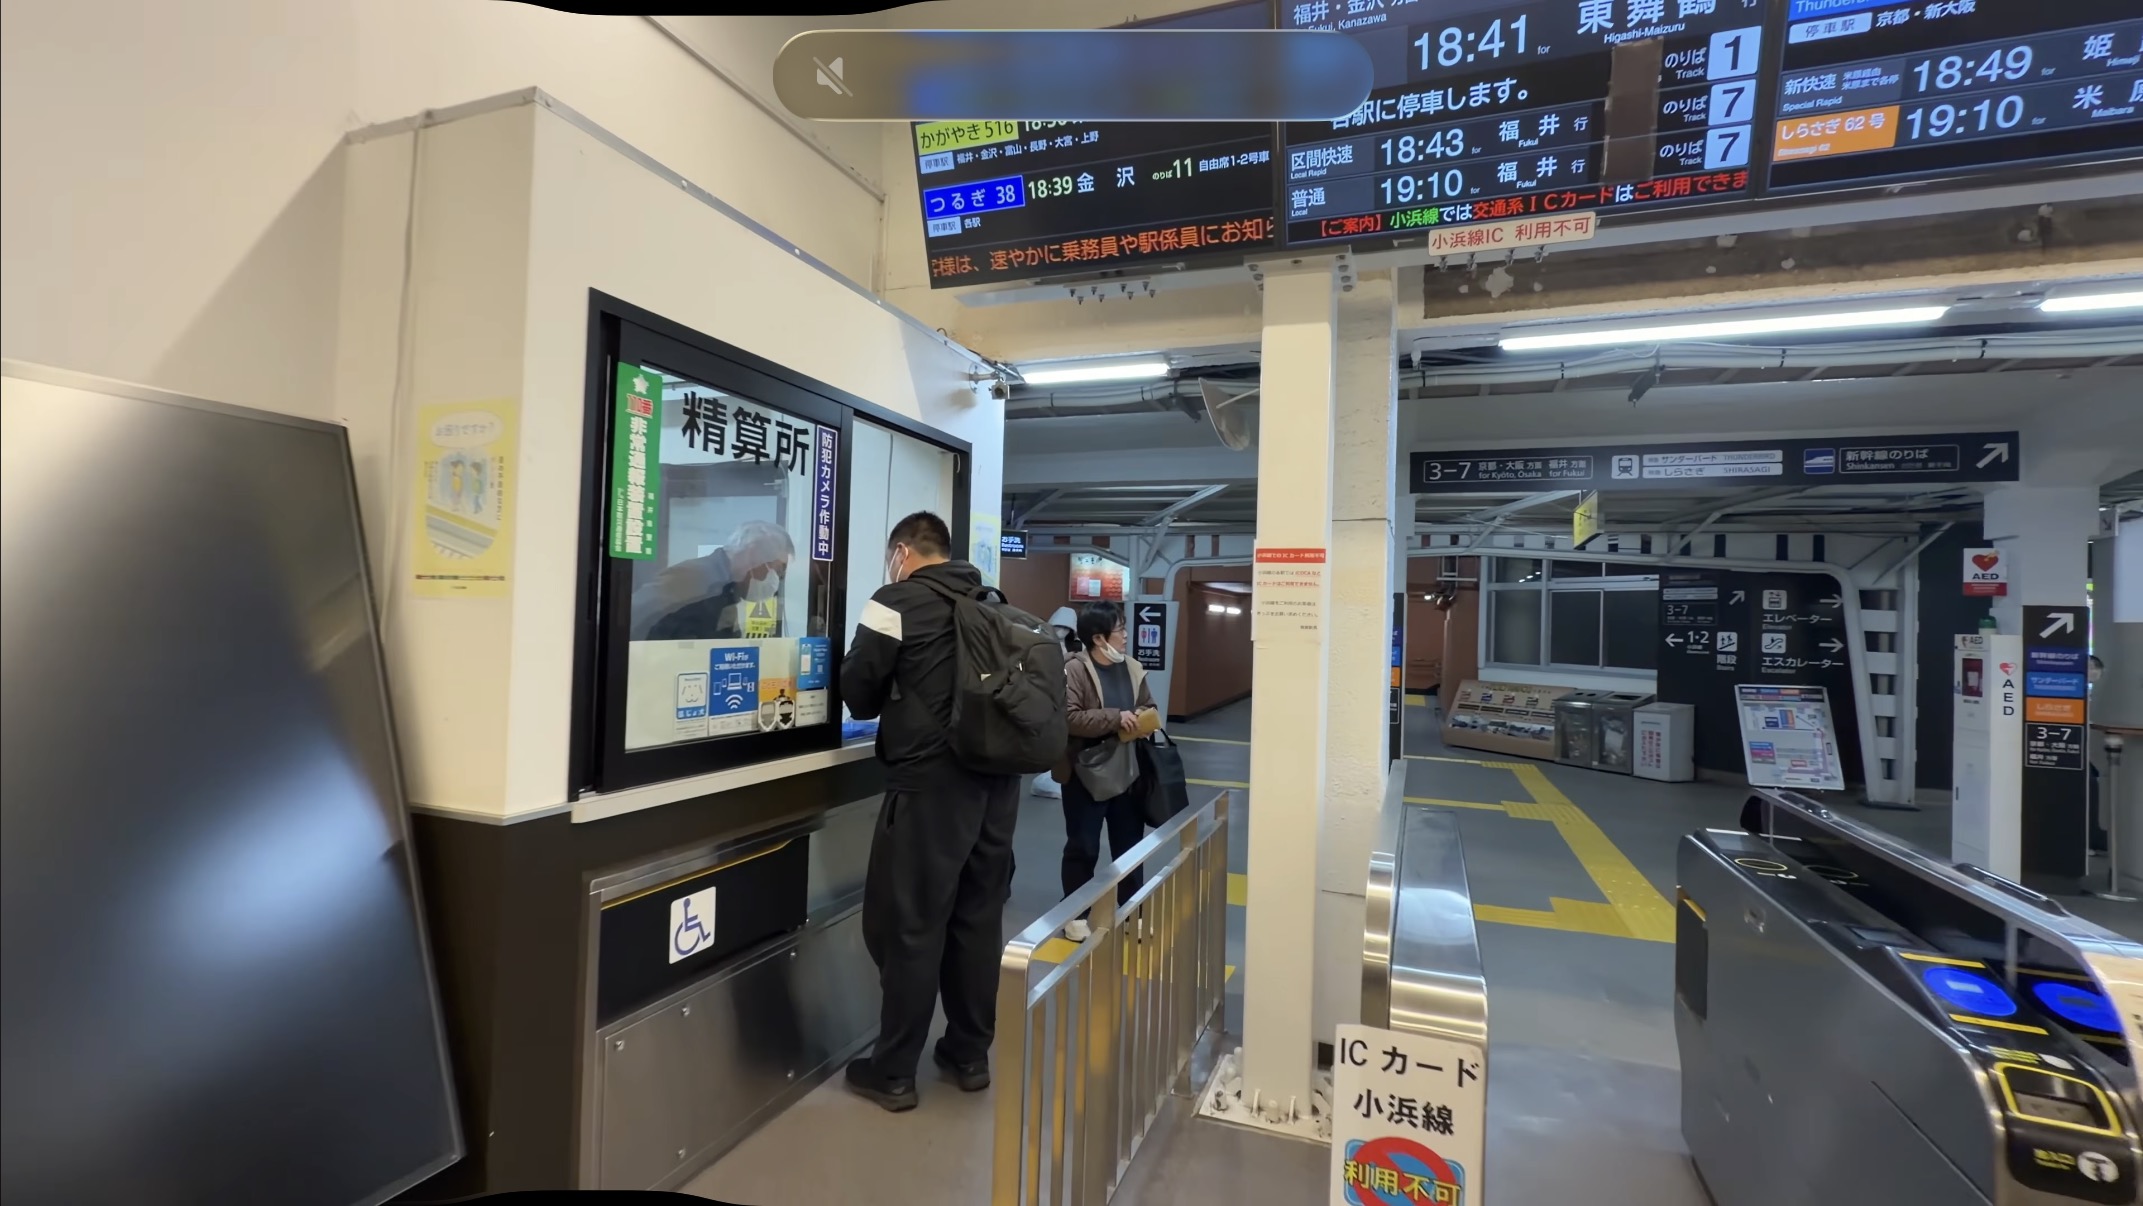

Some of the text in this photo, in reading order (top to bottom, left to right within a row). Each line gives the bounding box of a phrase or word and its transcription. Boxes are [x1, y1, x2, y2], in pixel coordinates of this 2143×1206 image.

[1338, 13, 1387, 30] Kanazawa
[1604, 22, 1685, 44] Higashi-Maizuru
[1805, 0, 1976, 38] 停車駅 京都・新大阪
[1414, 14, 1527, 71] 18:41
[1537, 45, 1551, 55] for
[1664, 34, 1742, 71] のりば 1
[1675, 66, 1705, 80] Track
[1913, 45, 2033, 92] 18:49
[1784, 73, 1837, 96] 新快速
[1662, 86, 1745, 118] のりば 7
[1782, 96, 1843, 113] Special Rapid
[1683, 113, 1706, 123] Track
[1782, 119, 1841, 140] しらさぎ
[1845, 116, 1865, 131] 62
[1906, 95, 2024, 139] 19:10
[920, 124, 980, 149] かがやき
[985, 121, 1014, 138] 516
[957, 130, 1099, 164] 福井・金沢・富山・長野・大宮・上野
[1291, 114, 1588, 172] 区間快速 18:43 for 福井 行
[1518, 137, 1539, 148] Fukui
[1659, 131, 1741, 163] のりば 7
[1290, 168, 1327, 180] Local Rapid
[1679, 157, 1703, 166] Track
[930, 151, 1270, 213] つるぎ 38 18:39 金沢 のりば 11 自由席1-2号車
[1291, 156, 1586, 210] 普通 19:10 for 福井 行
[1516, 178, 1537, 189] Fukui
[964, 217, 981, 229] 各駅
[1291, 208, 1308, 217] Local
[1431, 216, 1592, 250] 小浜線IC 利用不可
[681, 391, 810, 476] 精算所
[1723, 465, 1771, 473] SHIRASAGI
[1845, 449, 1929, 461] 新幹線のりば
[818, 432, 833, 556] 防犯カメラ作動中
[1763, 613, 1832, 624] エレベーター
[1969, 636, 1984, 645] AED
[1761, 657, 1844, 668] エスカレーター
[2002, 679, 2015, 716] AED
[1340, 1037, 1480, 1088] IC カード
[1353, 1088, 1455, 1136] 小浜線
[1343, 1159, 1463, 1206] 利用不可
